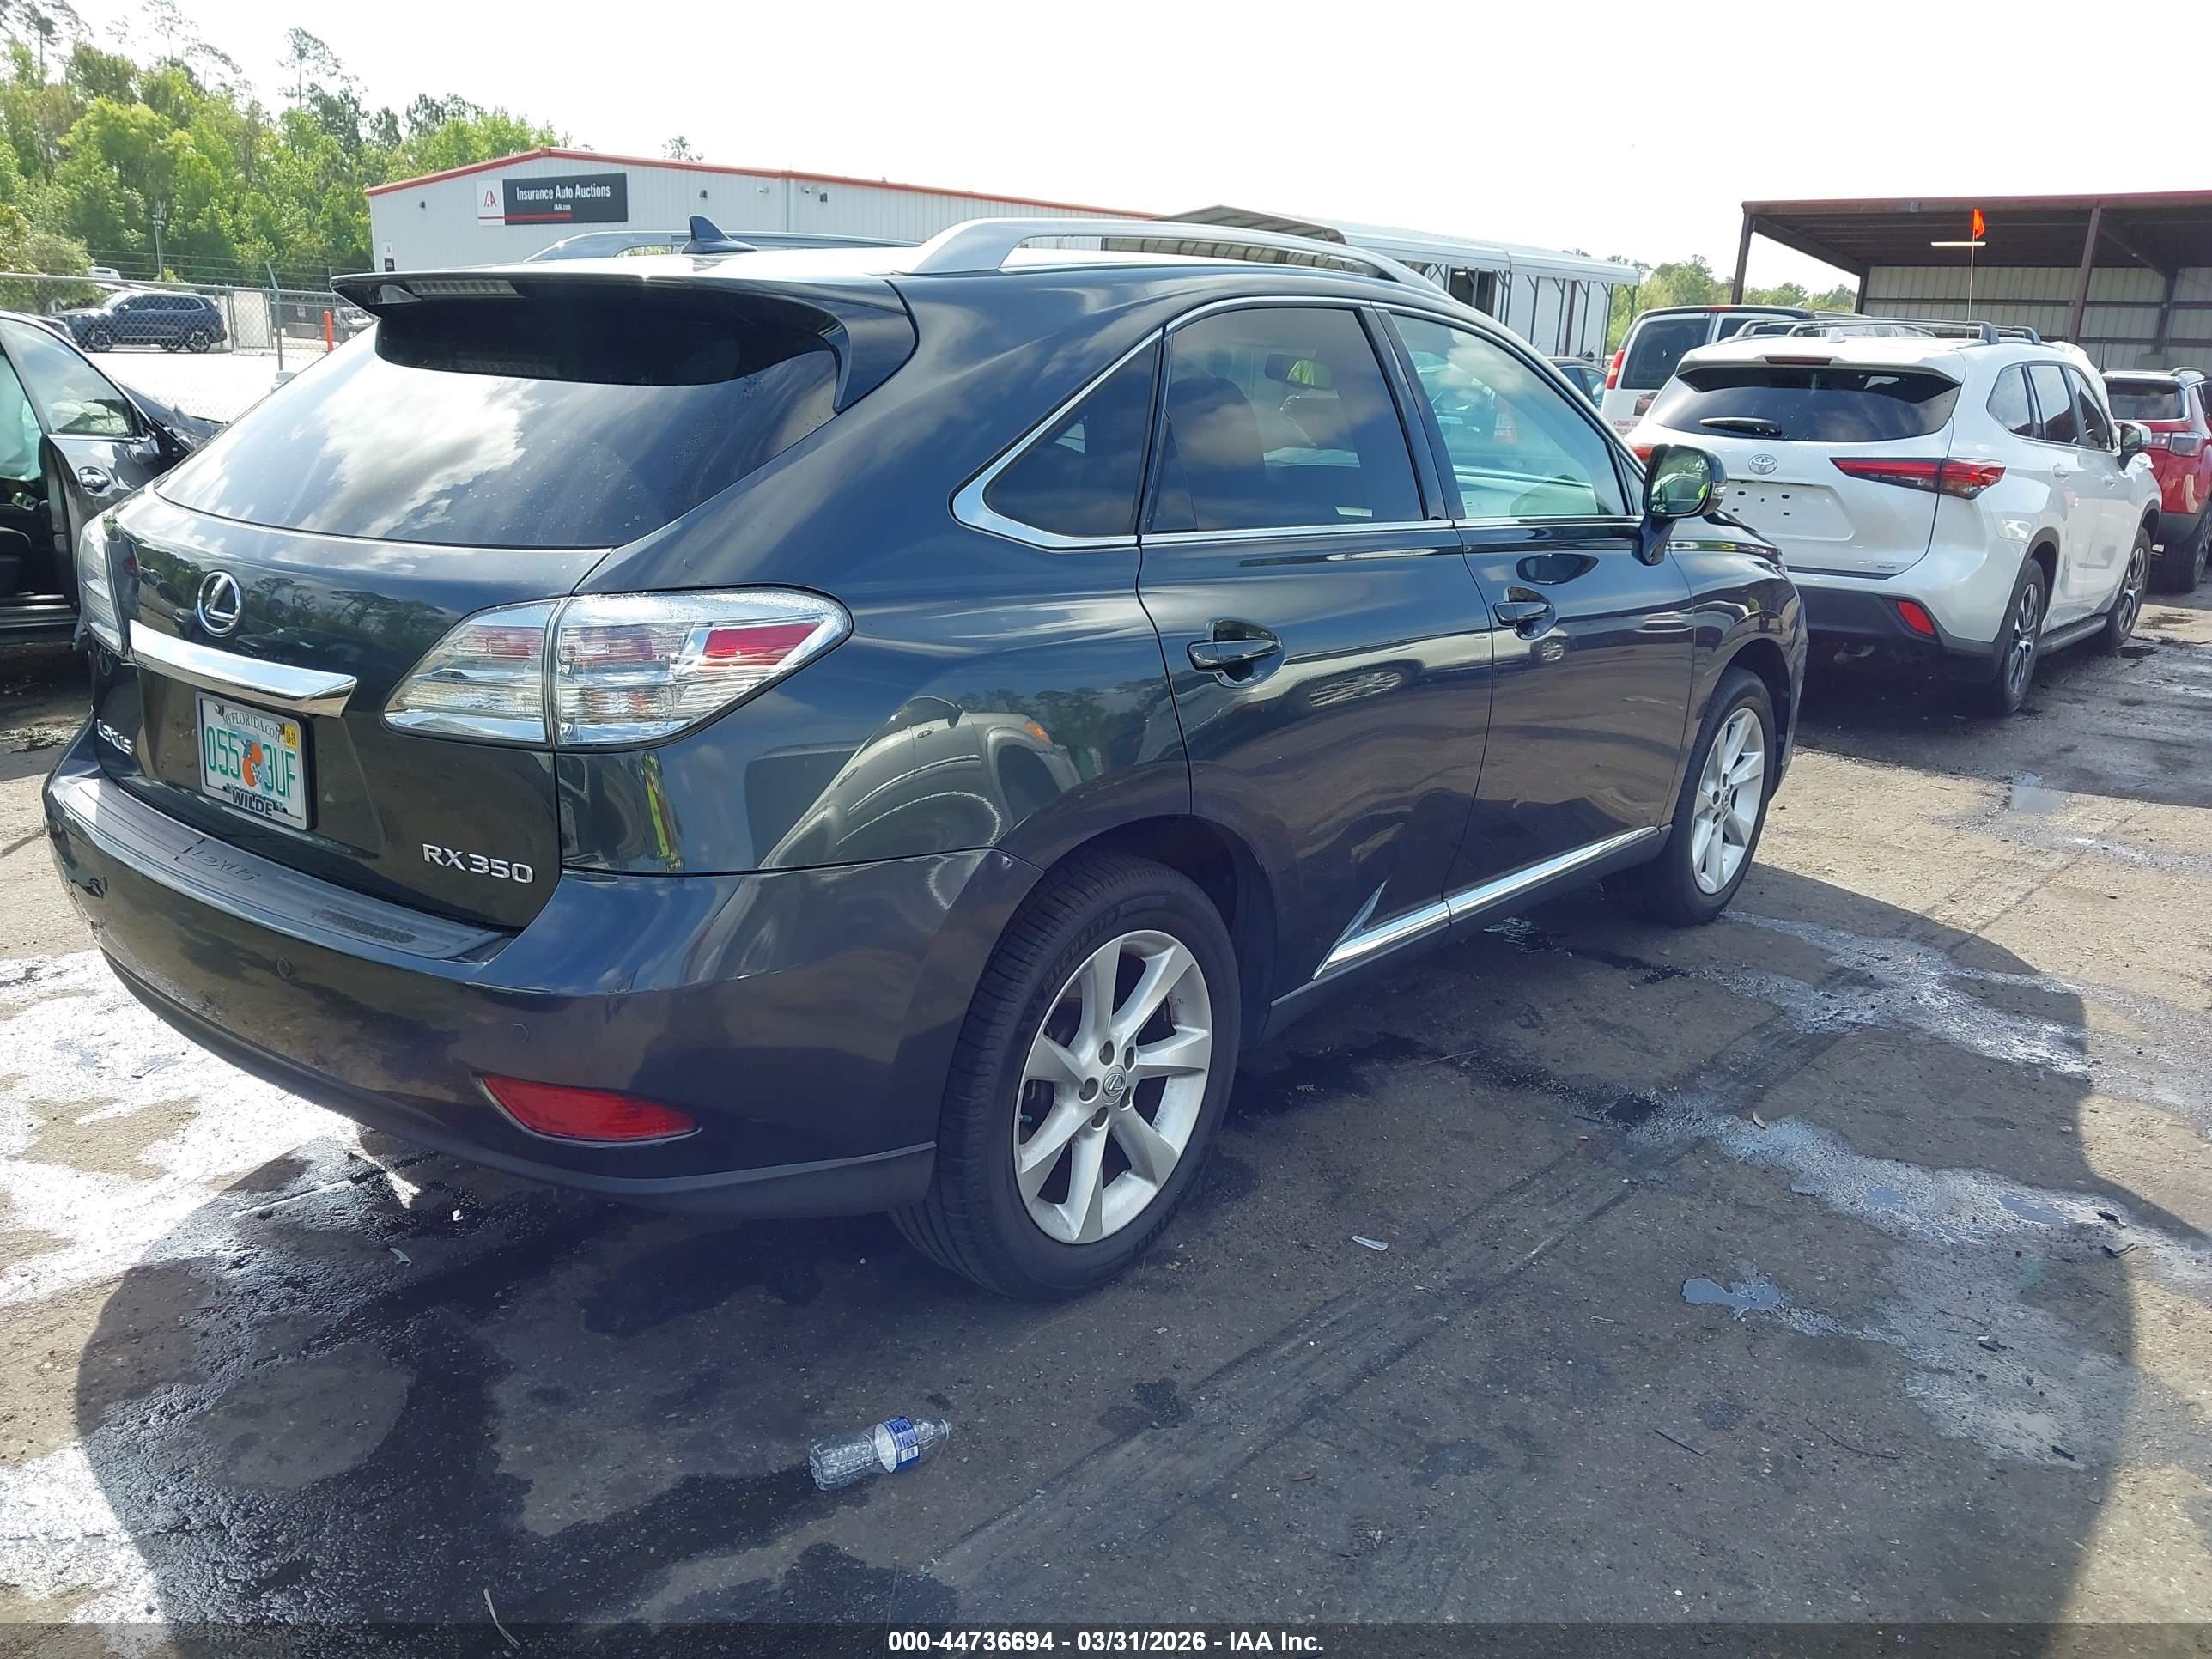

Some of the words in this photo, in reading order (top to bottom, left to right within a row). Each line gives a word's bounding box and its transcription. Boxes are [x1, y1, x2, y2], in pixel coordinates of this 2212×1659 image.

[516, 186, 554, 201] Insurance
[556, 184, 574, 199] Auto
[574, 183, 611, 198] Auctions
[232, 789, 273, 817] WILDE
[1042, 908, 1120, 995] MICHELIN
